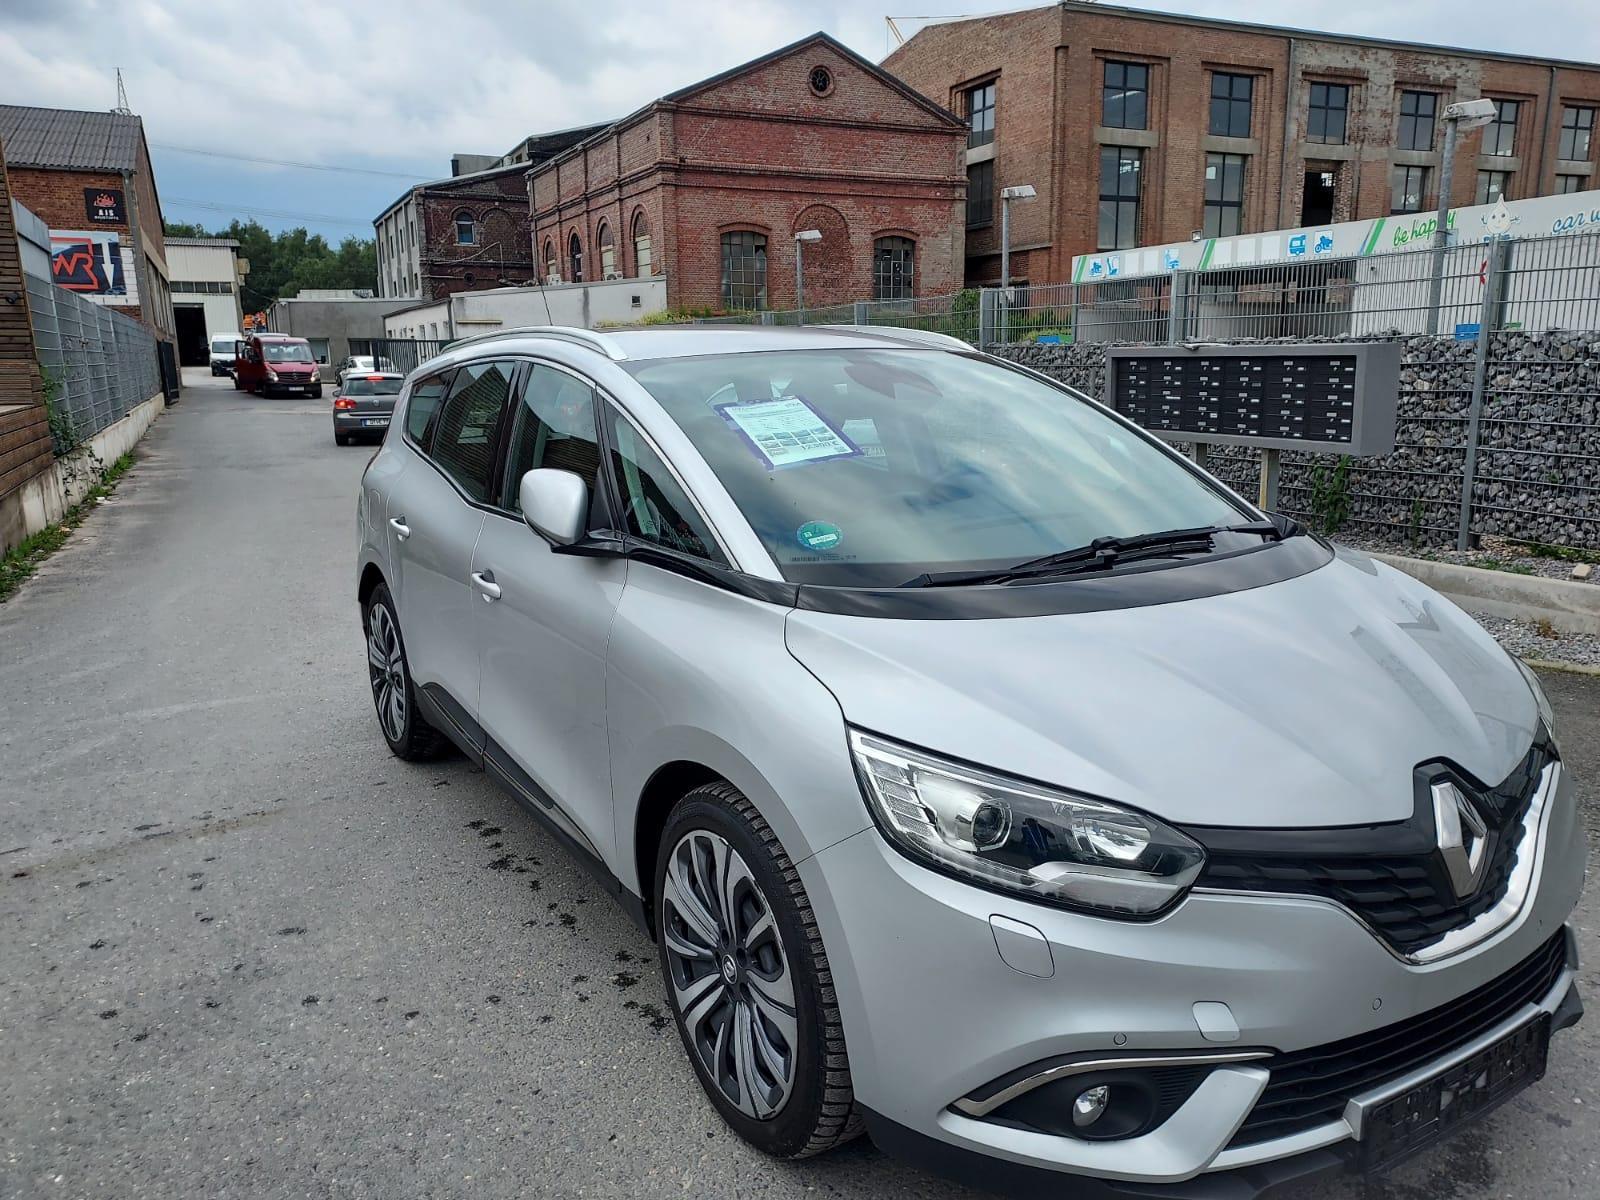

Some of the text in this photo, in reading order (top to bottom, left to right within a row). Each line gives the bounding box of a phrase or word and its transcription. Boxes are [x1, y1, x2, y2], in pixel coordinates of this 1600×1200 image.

[1393, 210, 1456, 246] be hapy
[1552, 212, 1585, 233] car
